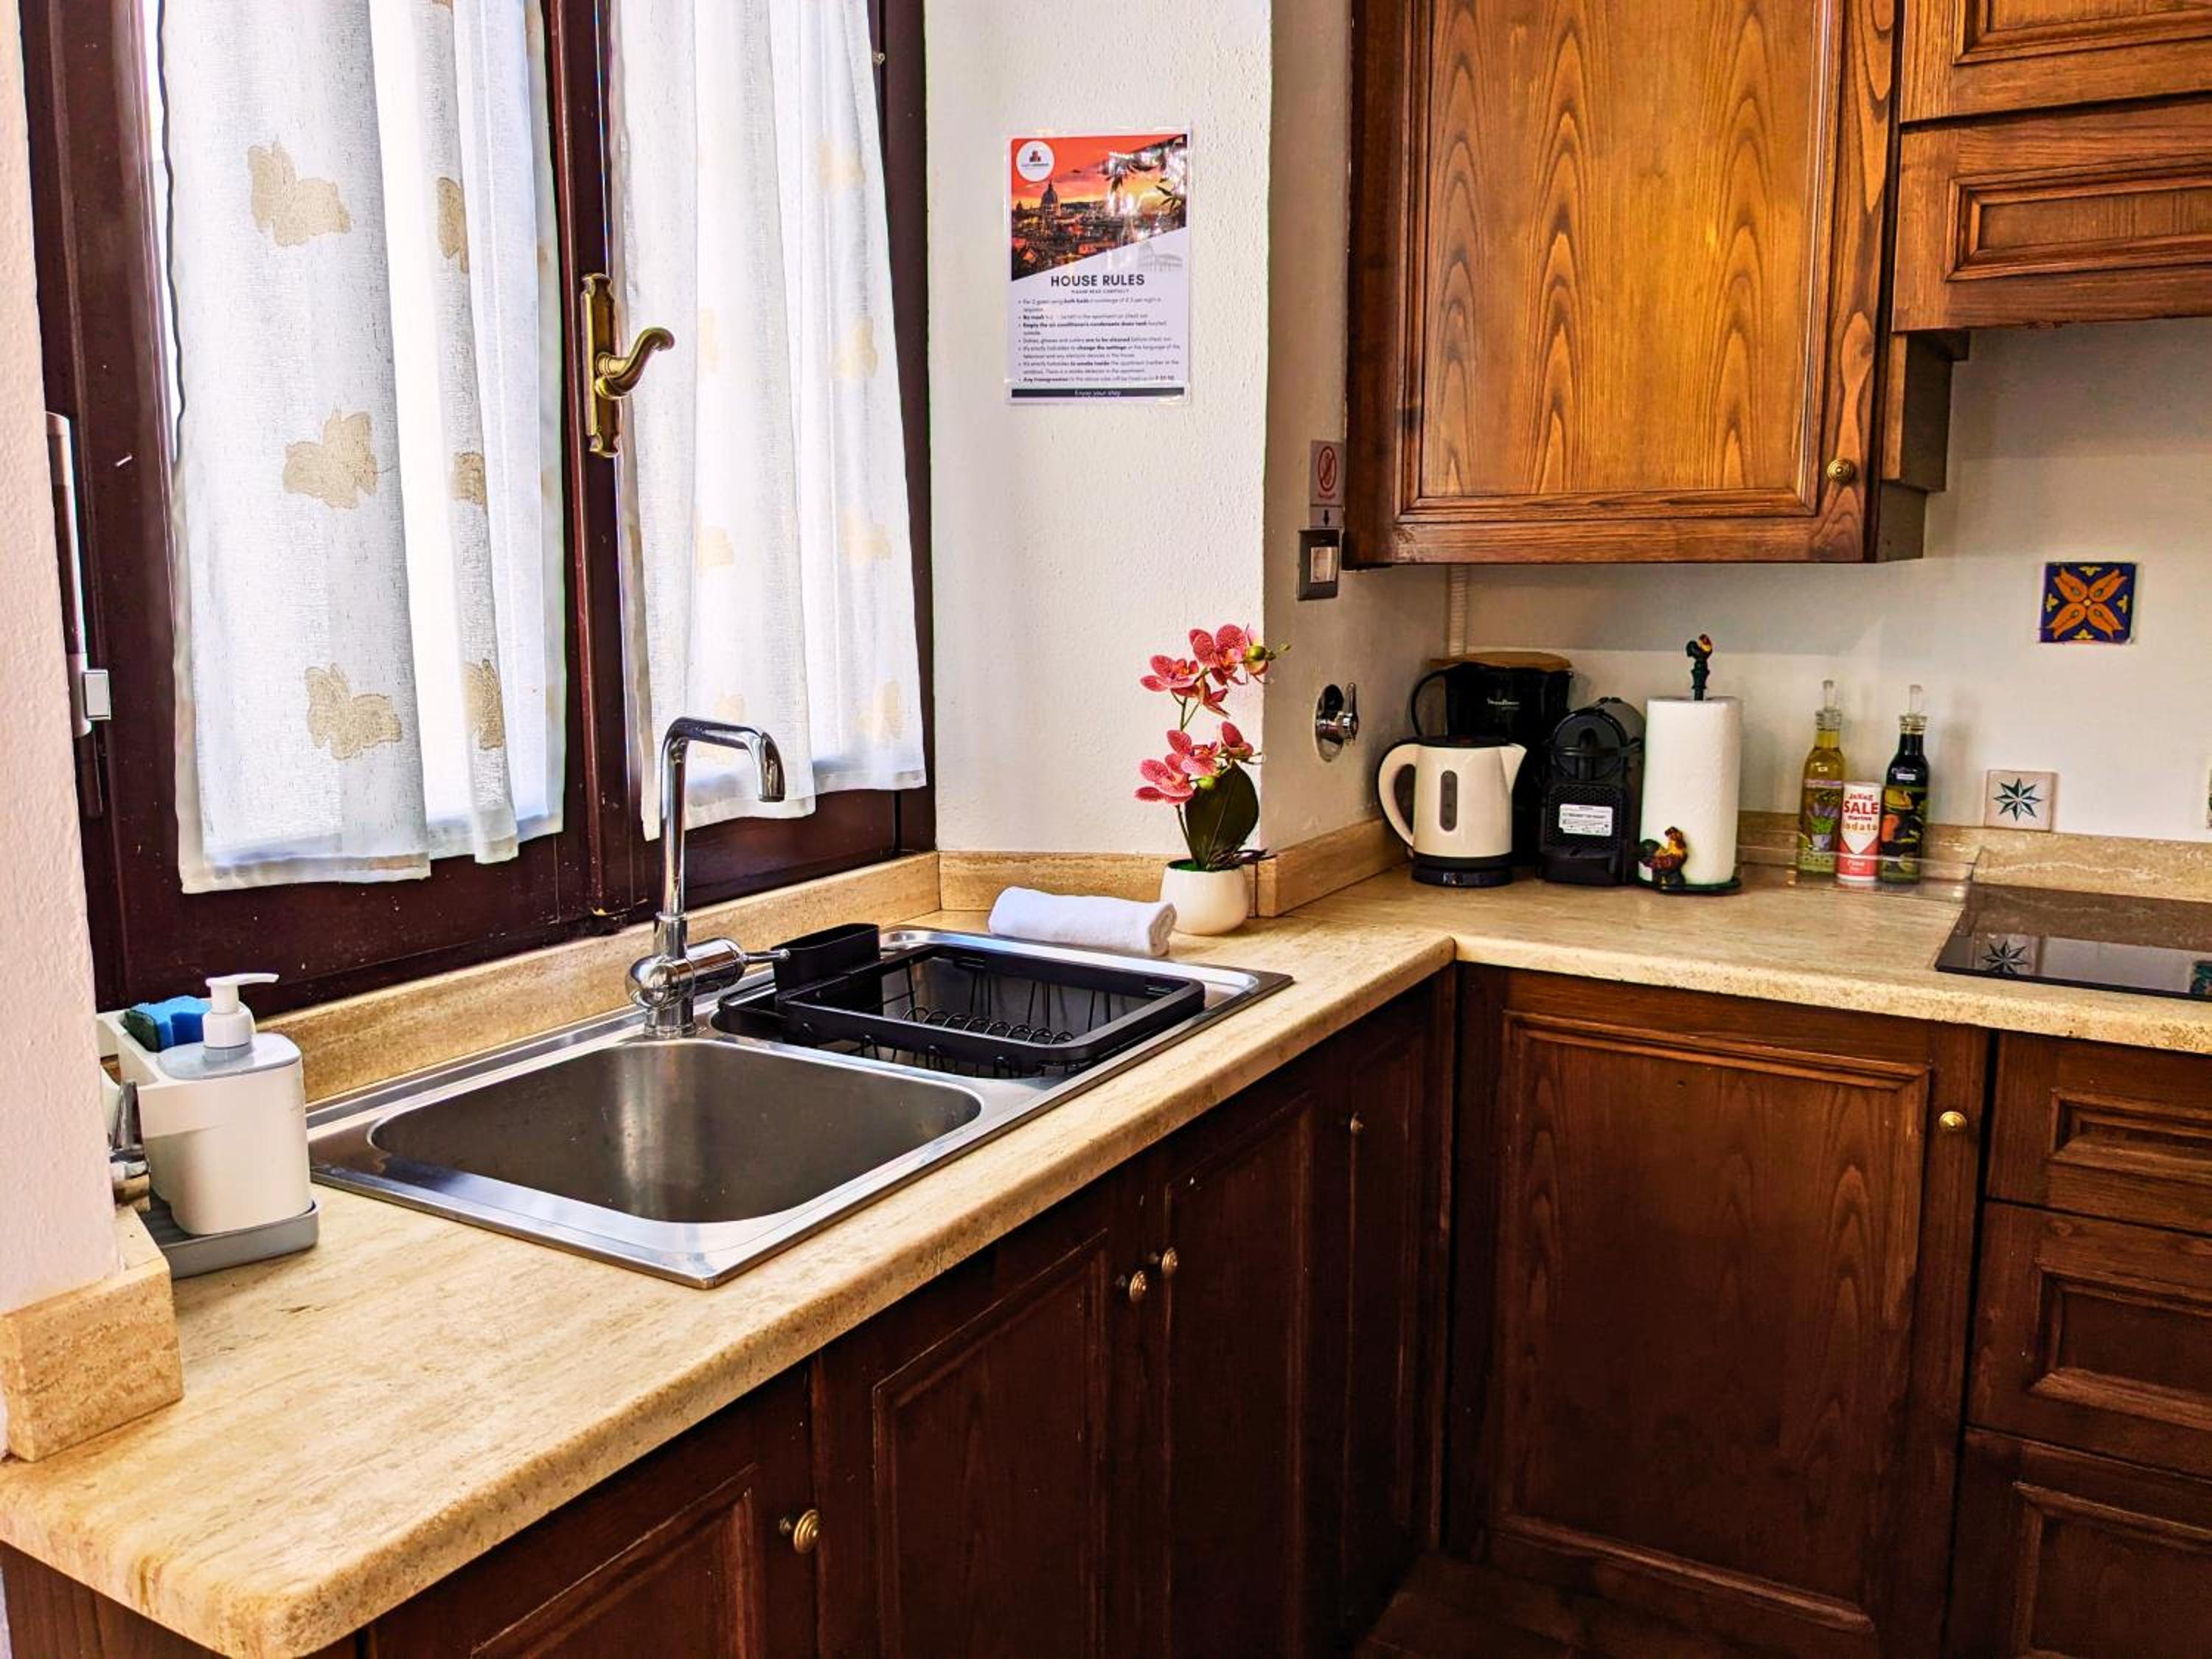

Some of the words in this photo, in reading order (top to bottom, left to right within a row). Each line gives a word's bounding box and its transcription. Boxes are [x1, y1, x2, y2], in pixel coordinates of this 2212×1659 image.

[1051, 275, 1098, 287] HOUSE
[1102, 274, 1145, 286] RULES
[1843, 800, 1879, 815] SALE
